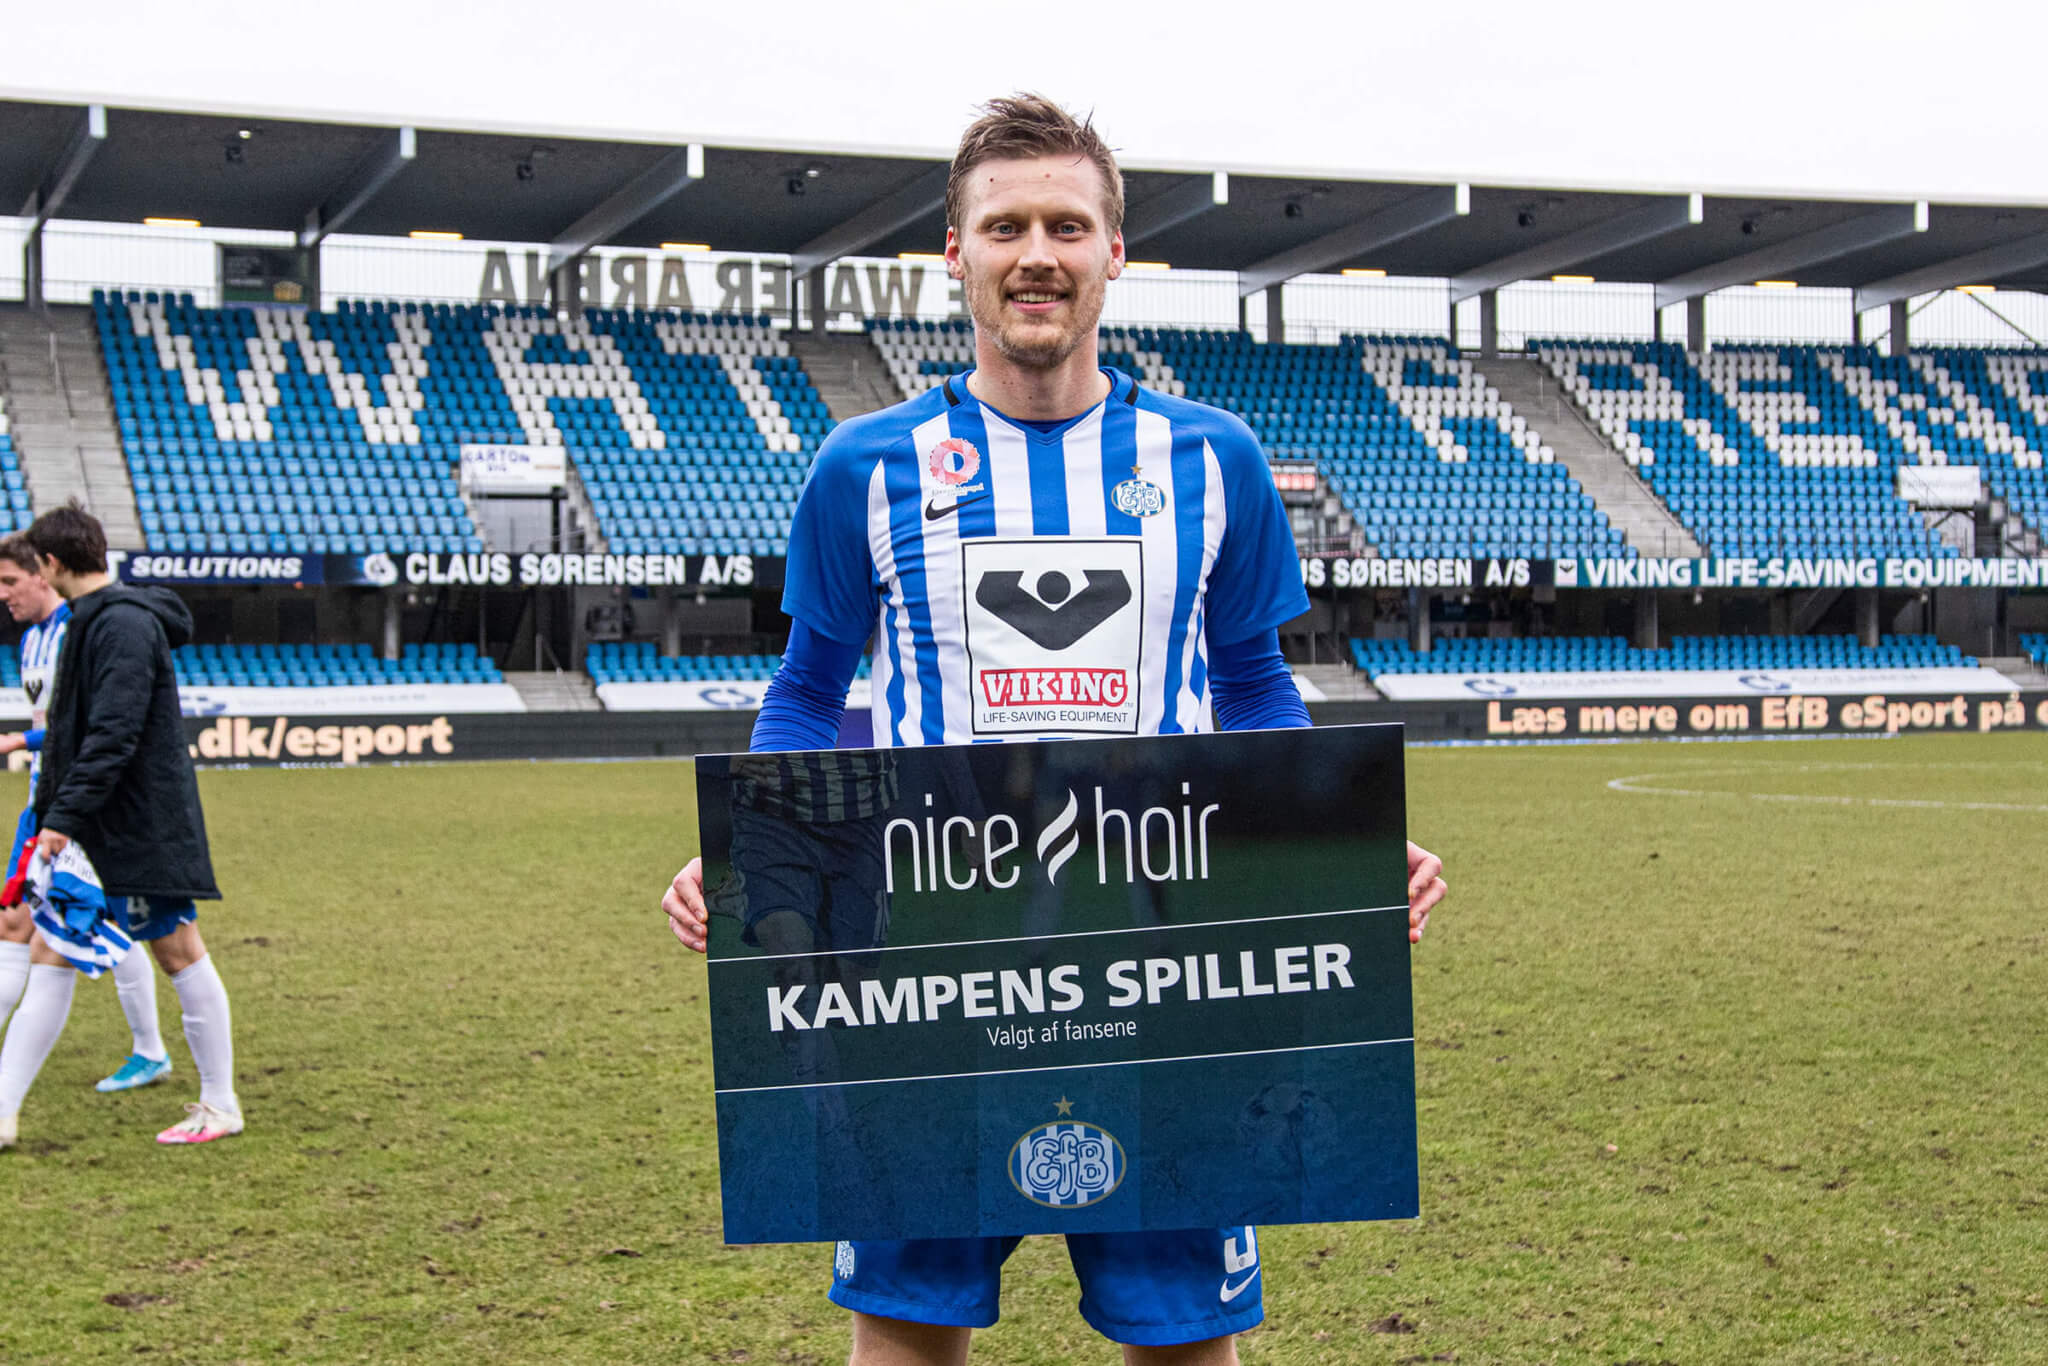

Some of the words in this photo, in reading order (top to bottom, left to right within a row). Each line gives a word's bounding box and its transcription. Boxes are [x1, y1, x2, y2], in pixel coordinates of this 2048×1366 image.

[130, 556, 303, 579] SOLUTIONS
[405, 553, 512, 586] CLAUS
[519, 553, 686, 586] SØRENSEN
[699, 554, 754, 585] A/S
[1333, 557, 1473, 587] SØRENSEN
[1484, 558, 1530, 586] A/S
[1584, 558, 1691, 588] VIKING
[1701, 557, 1877, 587] LIFE-SAVING
[982, 669, 1127, 707] VIKING
[983, 711, 1057, 723] LIFE-SAVING
[1060, 711, 1129, 723] EQUIPMENT
[1487, 700, 1567, 735] Læs
[1579, 703, 1677, 733] mere
[1689, 702, 1750, 731] om
[1761, 698, 1830, 730] EfB
[1841, 695, 1968, 733] eSport
[1979, 691, 2025, 732] på
[884, 793, 1021, 894] nice
[1094, 782, 1220, 885] hair
[766, 963, 1086, 1032] KAMPENS
[1107, 943, 1356, 1009] SPILLER
[986, 1026, 1035, 1050] Valgt
[1040, 1023, 1059, 1043] af
[1064, 1017, 1138, 1041] fansene
[1026, 1129, 1110, 1199] EfB
